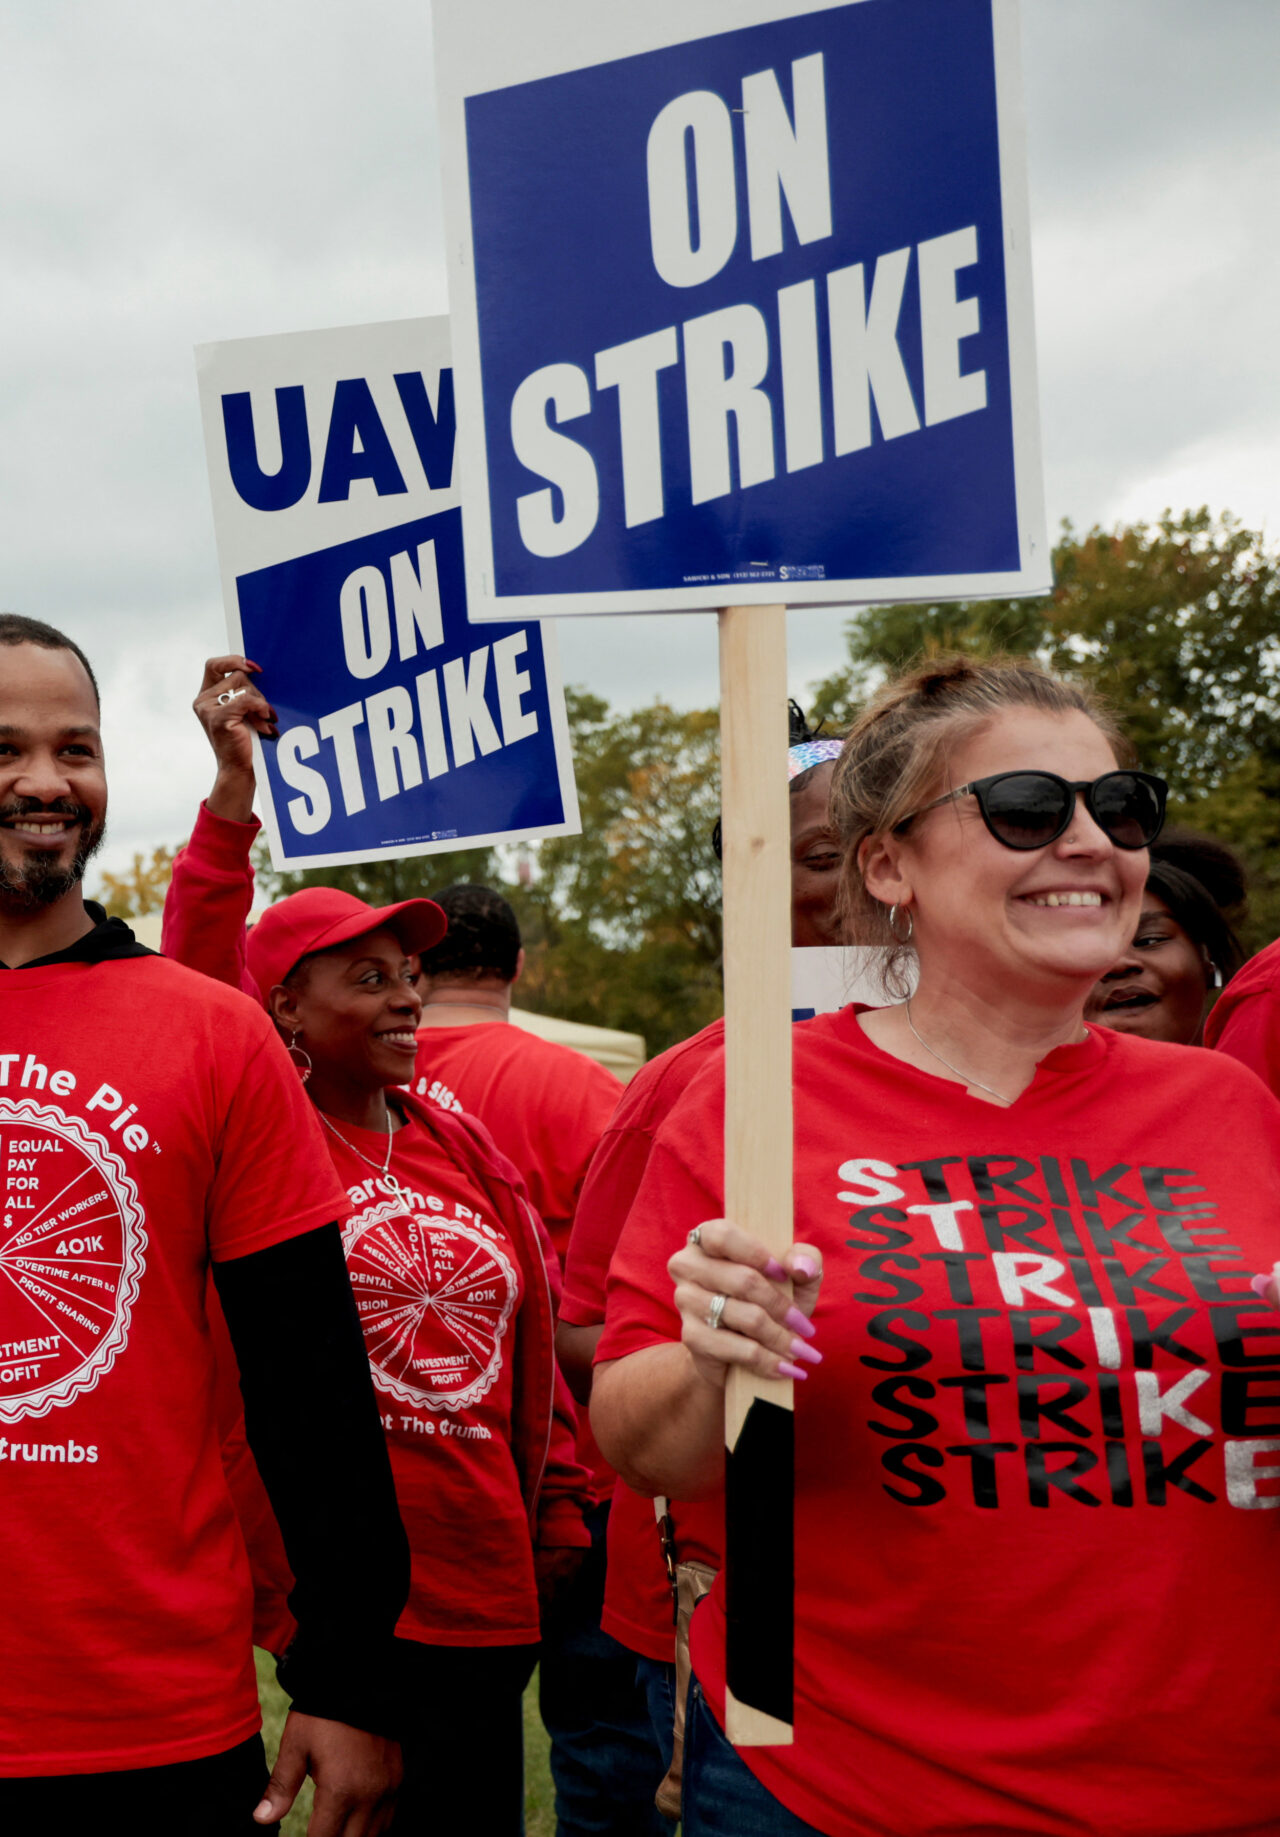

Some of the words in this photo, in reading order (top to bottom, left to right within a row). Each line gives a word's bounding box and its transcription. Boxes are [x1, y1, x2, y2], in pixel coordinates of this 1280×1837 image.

[646, 51, 833, 289] ON
[510, 225, 987, 558] STRIKE
[339, 538, 445, 680] ON
[277, 629, 539, 836] STRIKE
[428, 1081, 463, 1114] SIST
[85, 1083, 150, 1153] Pie
[9, 1140, 63, 1153] EQUAL
[8, 1158, 37, 1172] PAY
[6, 1177, 39, 1190] FOR
[837, 1154, 1219, 1211] STRIKE
[5, 1196, 35, 1209] ALL
[403, 1187, 444, 1211] he
[3, 1213, 13, 1229] $
[16, 1232, 33, 1246] NO
[33, 1218, 58, 1236] TIER
[57, 1190, 108, 1221] WORKERS
[846, 1201, 1242, 1256] STRIKE
[55, 1235, 104, 1257] 401K
[432, 1248, 455, 1259] FOR
[16, 1259, 69, 1279] OVERTIME
[71, 1273, 103, 1288] AFTER
[363, 1244, 407, 1280] MEDICAL
[434, 1260, 454, 1271] ALL
[350, 1272, 393, 1290] DENTAL
[853, 1252, 1266, 1307] STRIKE
[19, 1276, 57, 1304] PROFIT
[56, 1301, 101, 1335] SHARING
[356, 1299, 389, 1312] ISION
[467, 1289, 496, 1303] 401K
[859, 1305, 1280, 1371] STRIKE
[412, 1355, 471, 1370] INVESTMENT
[431, 1372, 462, 1386] PROFIT
[867, 1369, 1280, 1440] STRIKE
[400, 1416, 435, 1434] The
[881, 1439, 1280, 1510] STRIKE
